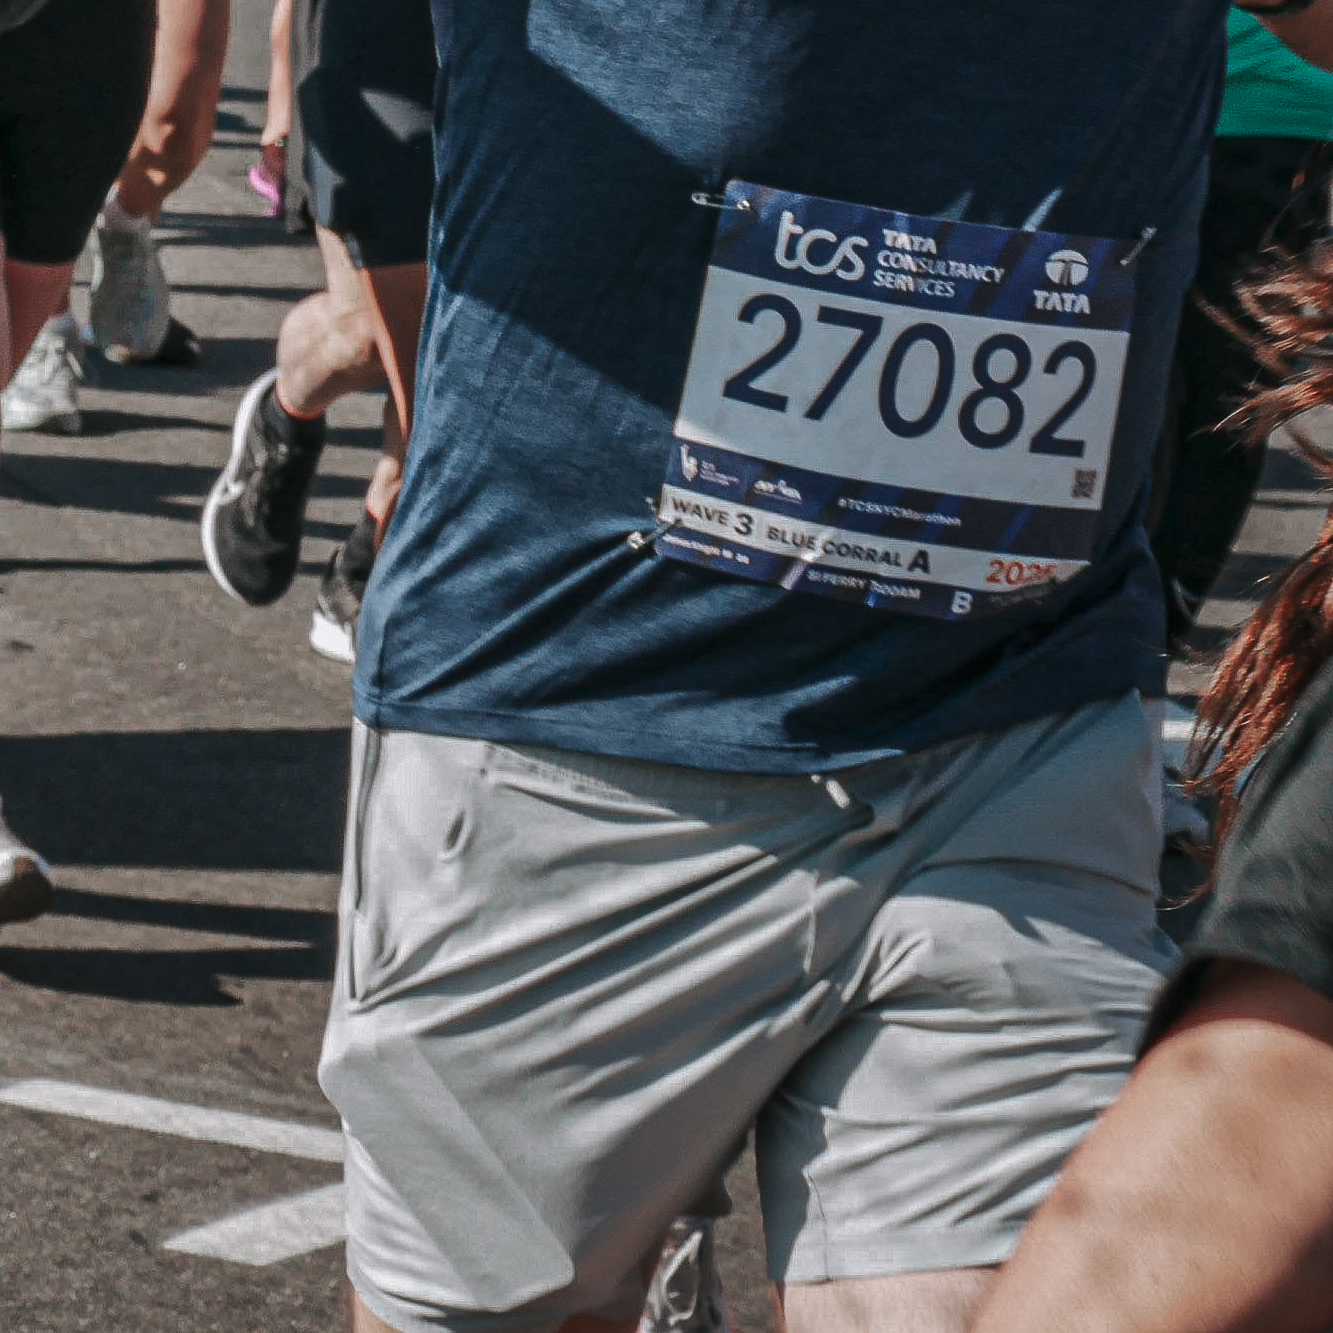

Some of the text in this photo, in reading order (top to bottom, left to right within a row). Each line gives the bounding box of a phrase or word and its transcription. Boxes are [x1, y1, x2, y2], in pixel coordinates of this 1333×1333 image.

[774, 210, 869, 281] tcs
[882, 228, 937, 255] TATA
[876, 249, 1005, 284] CONSULTANCY
[873, 269, 955, 298] SERVICES
[1033, 289, 1091, 315] TATA
[722, 293, 1097, 458] 27082
[672, 498, 729, 526] WAVE
[733, 513, 753, 537] 3
[766, 526, 817, 552] BLUE
[822, 540, 902, 568] CORRAL
[907, 549, 931, 575] A
[951, 590, 973, 615] B
